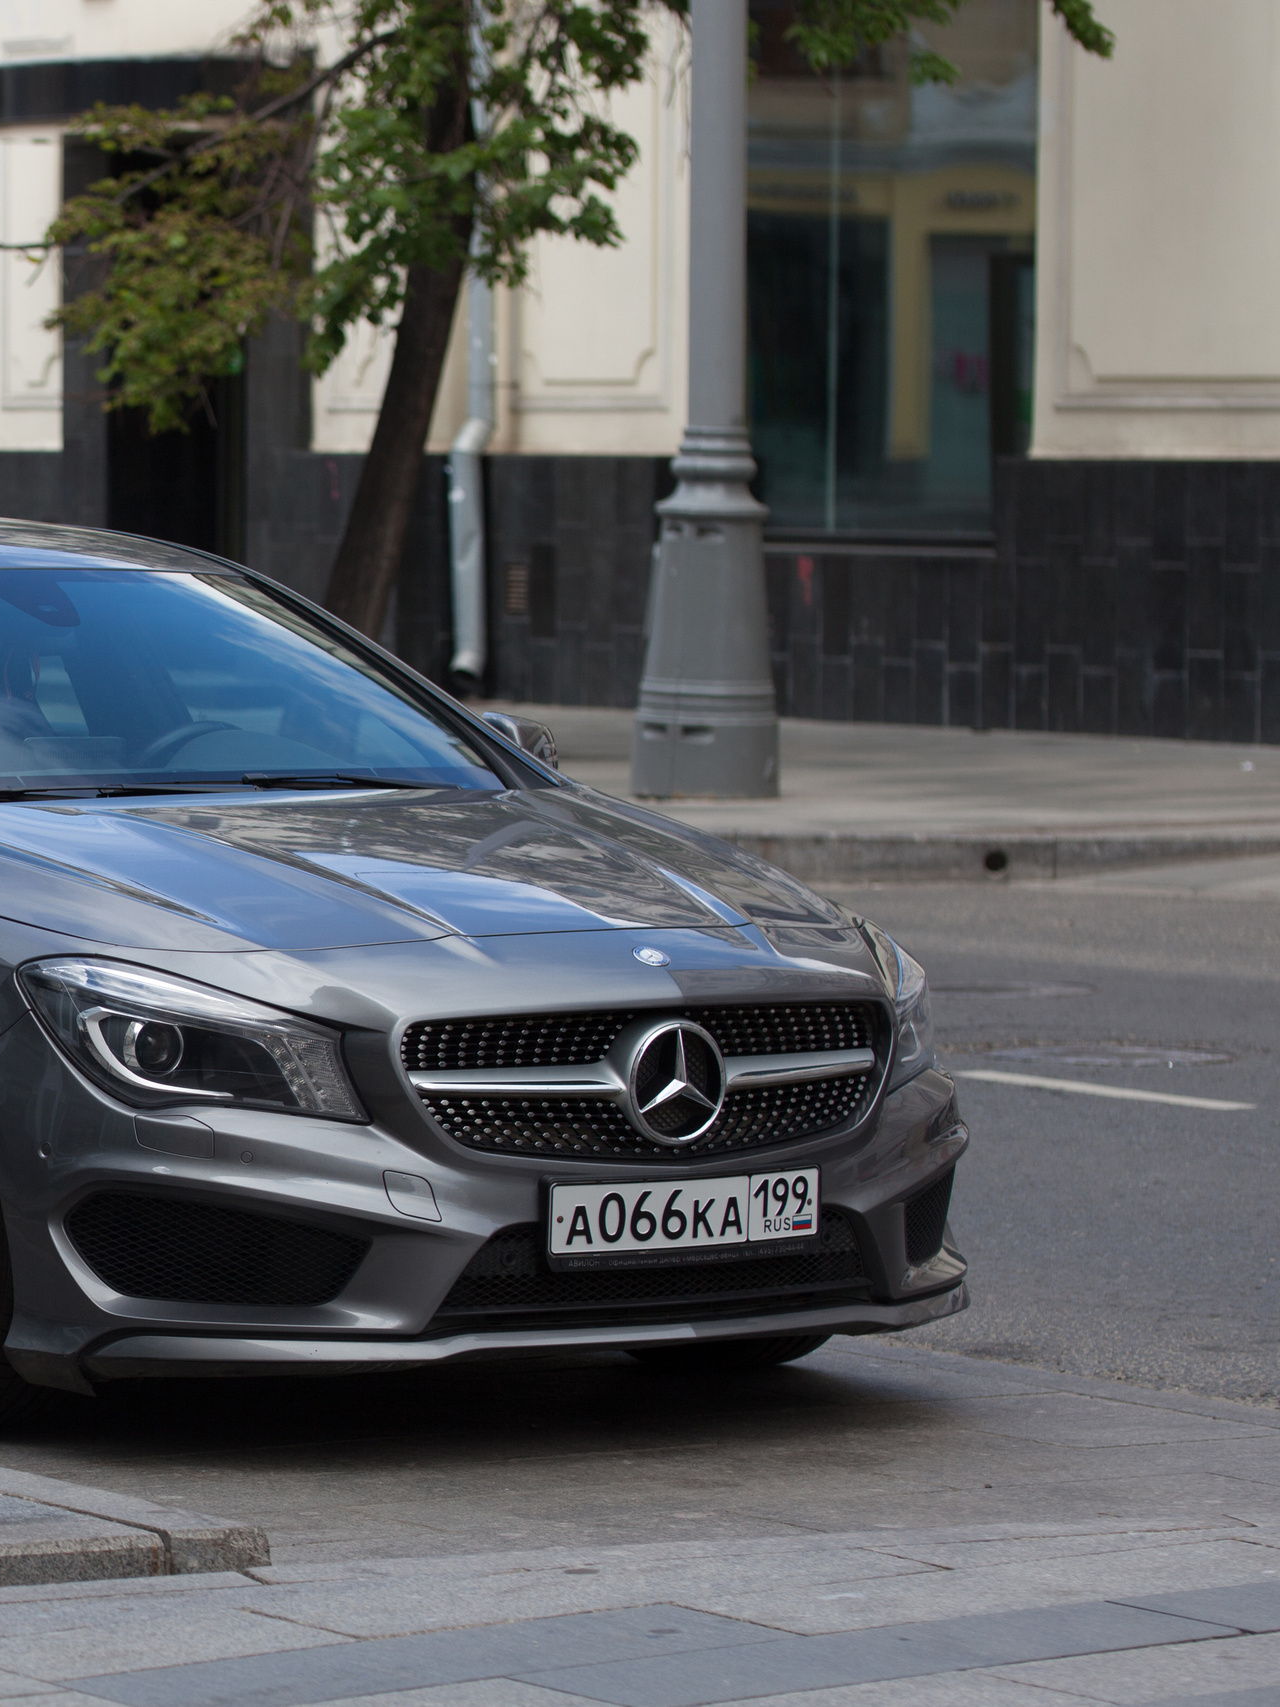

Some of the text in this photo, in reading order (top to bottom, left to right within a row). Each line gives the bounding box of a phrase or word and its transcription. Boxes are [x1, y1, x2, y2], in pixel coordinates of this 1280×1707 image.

[566, 1175, 809, 1245] А066КА 199
[763, 1217, 791, 1233] RUS
[568, 1259, 600, 1268] АВИЛОН
